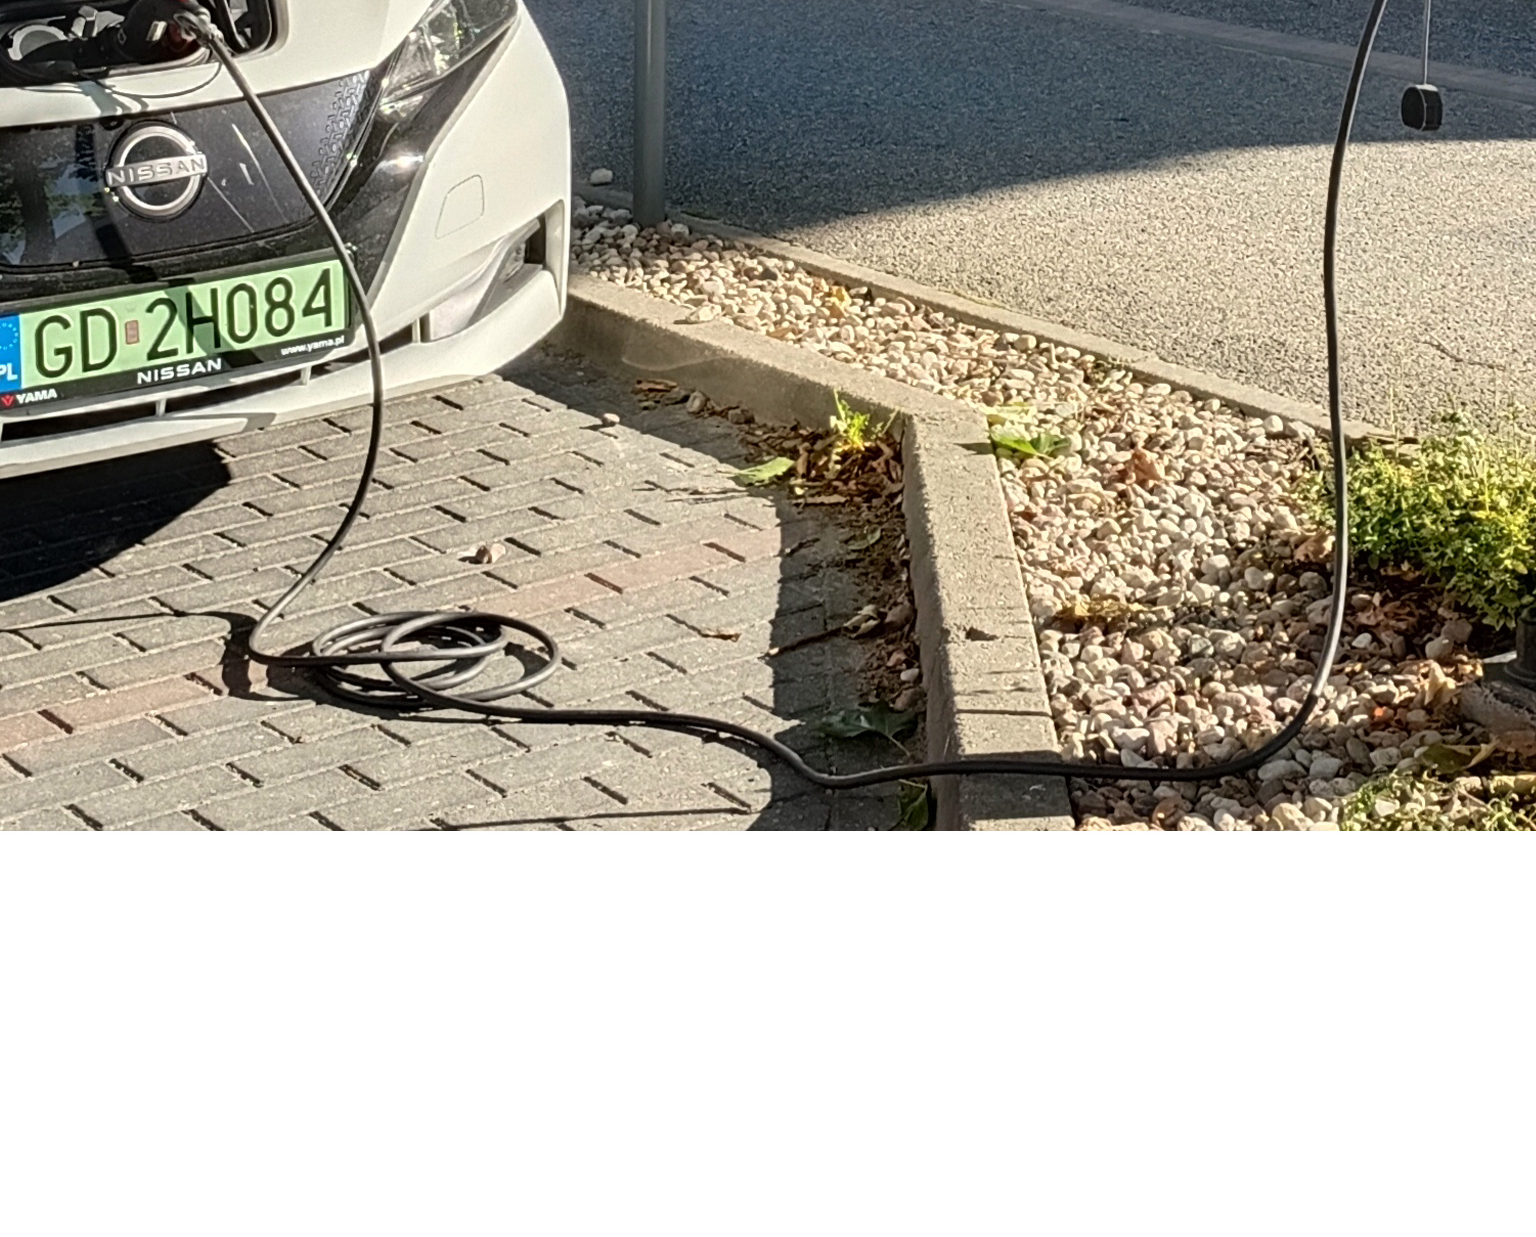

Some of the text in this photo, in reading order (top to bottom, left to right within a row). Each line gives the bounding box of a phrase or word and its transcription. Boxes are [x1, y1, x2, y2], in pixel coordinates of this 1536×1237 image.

[107, 157, 205, 187] NISSAN
[34, 267, 335, 379] GD 2H084
[280, 334, 345, 356] www.yama.pl
[136, 357, 222, 385] NISSAN
[16, 387, 58, 405] YAMA
